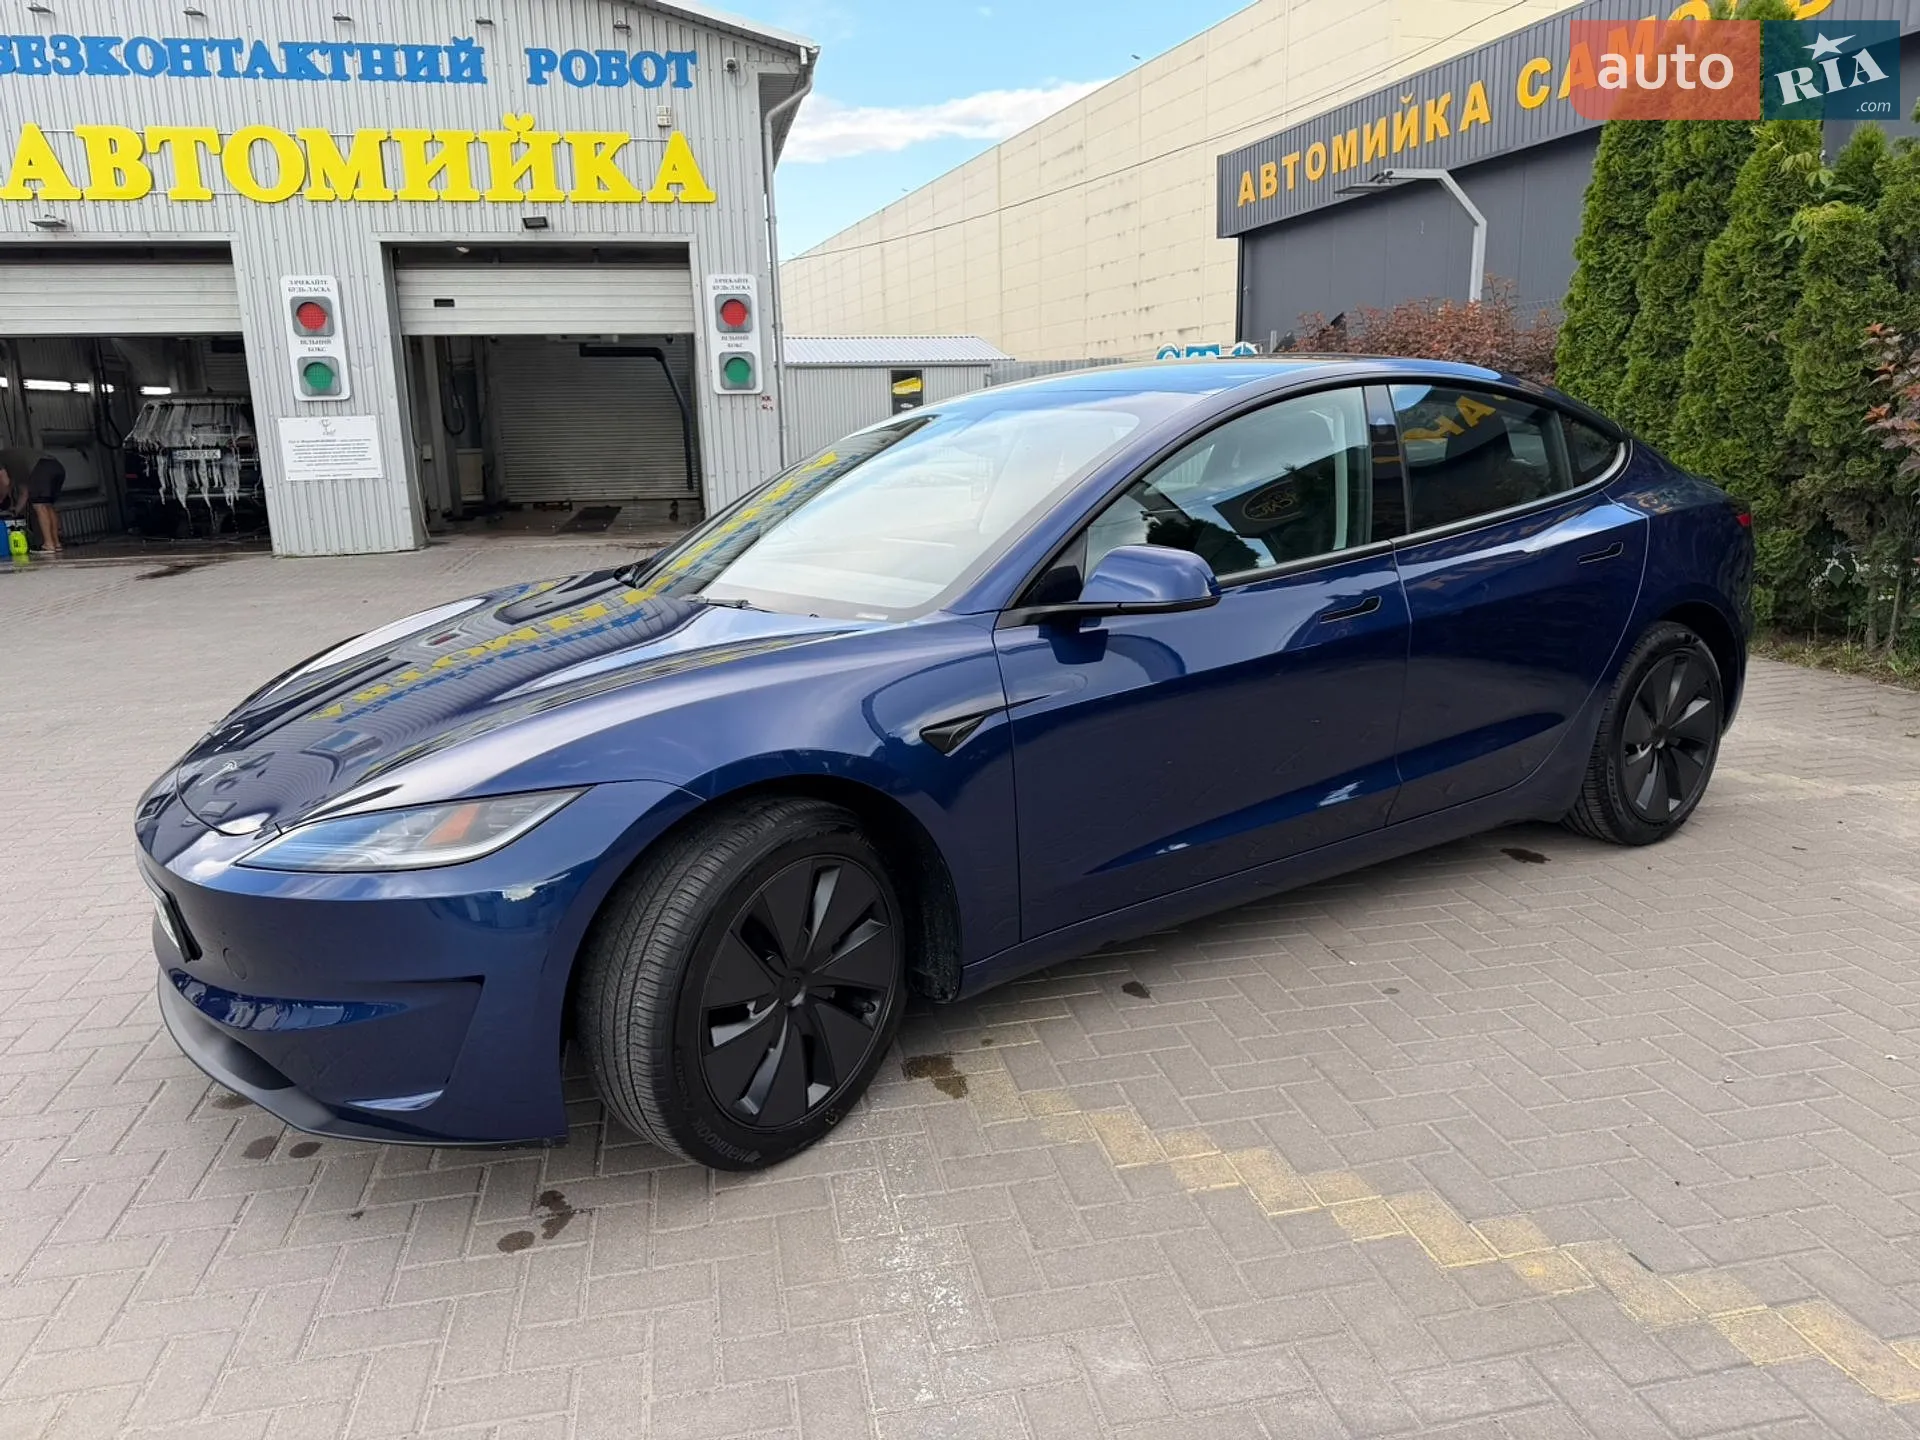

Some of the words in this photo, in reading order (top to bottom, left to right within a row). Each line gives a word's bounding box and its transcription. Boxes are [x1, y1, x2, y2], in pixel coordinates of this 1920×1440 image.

[524, 47, 698, 89] РОБОТ
[0, 112, 717, 203] АВТОМИЙКА
[1237, 80, 1491, 207] АВТОМИЙКА
